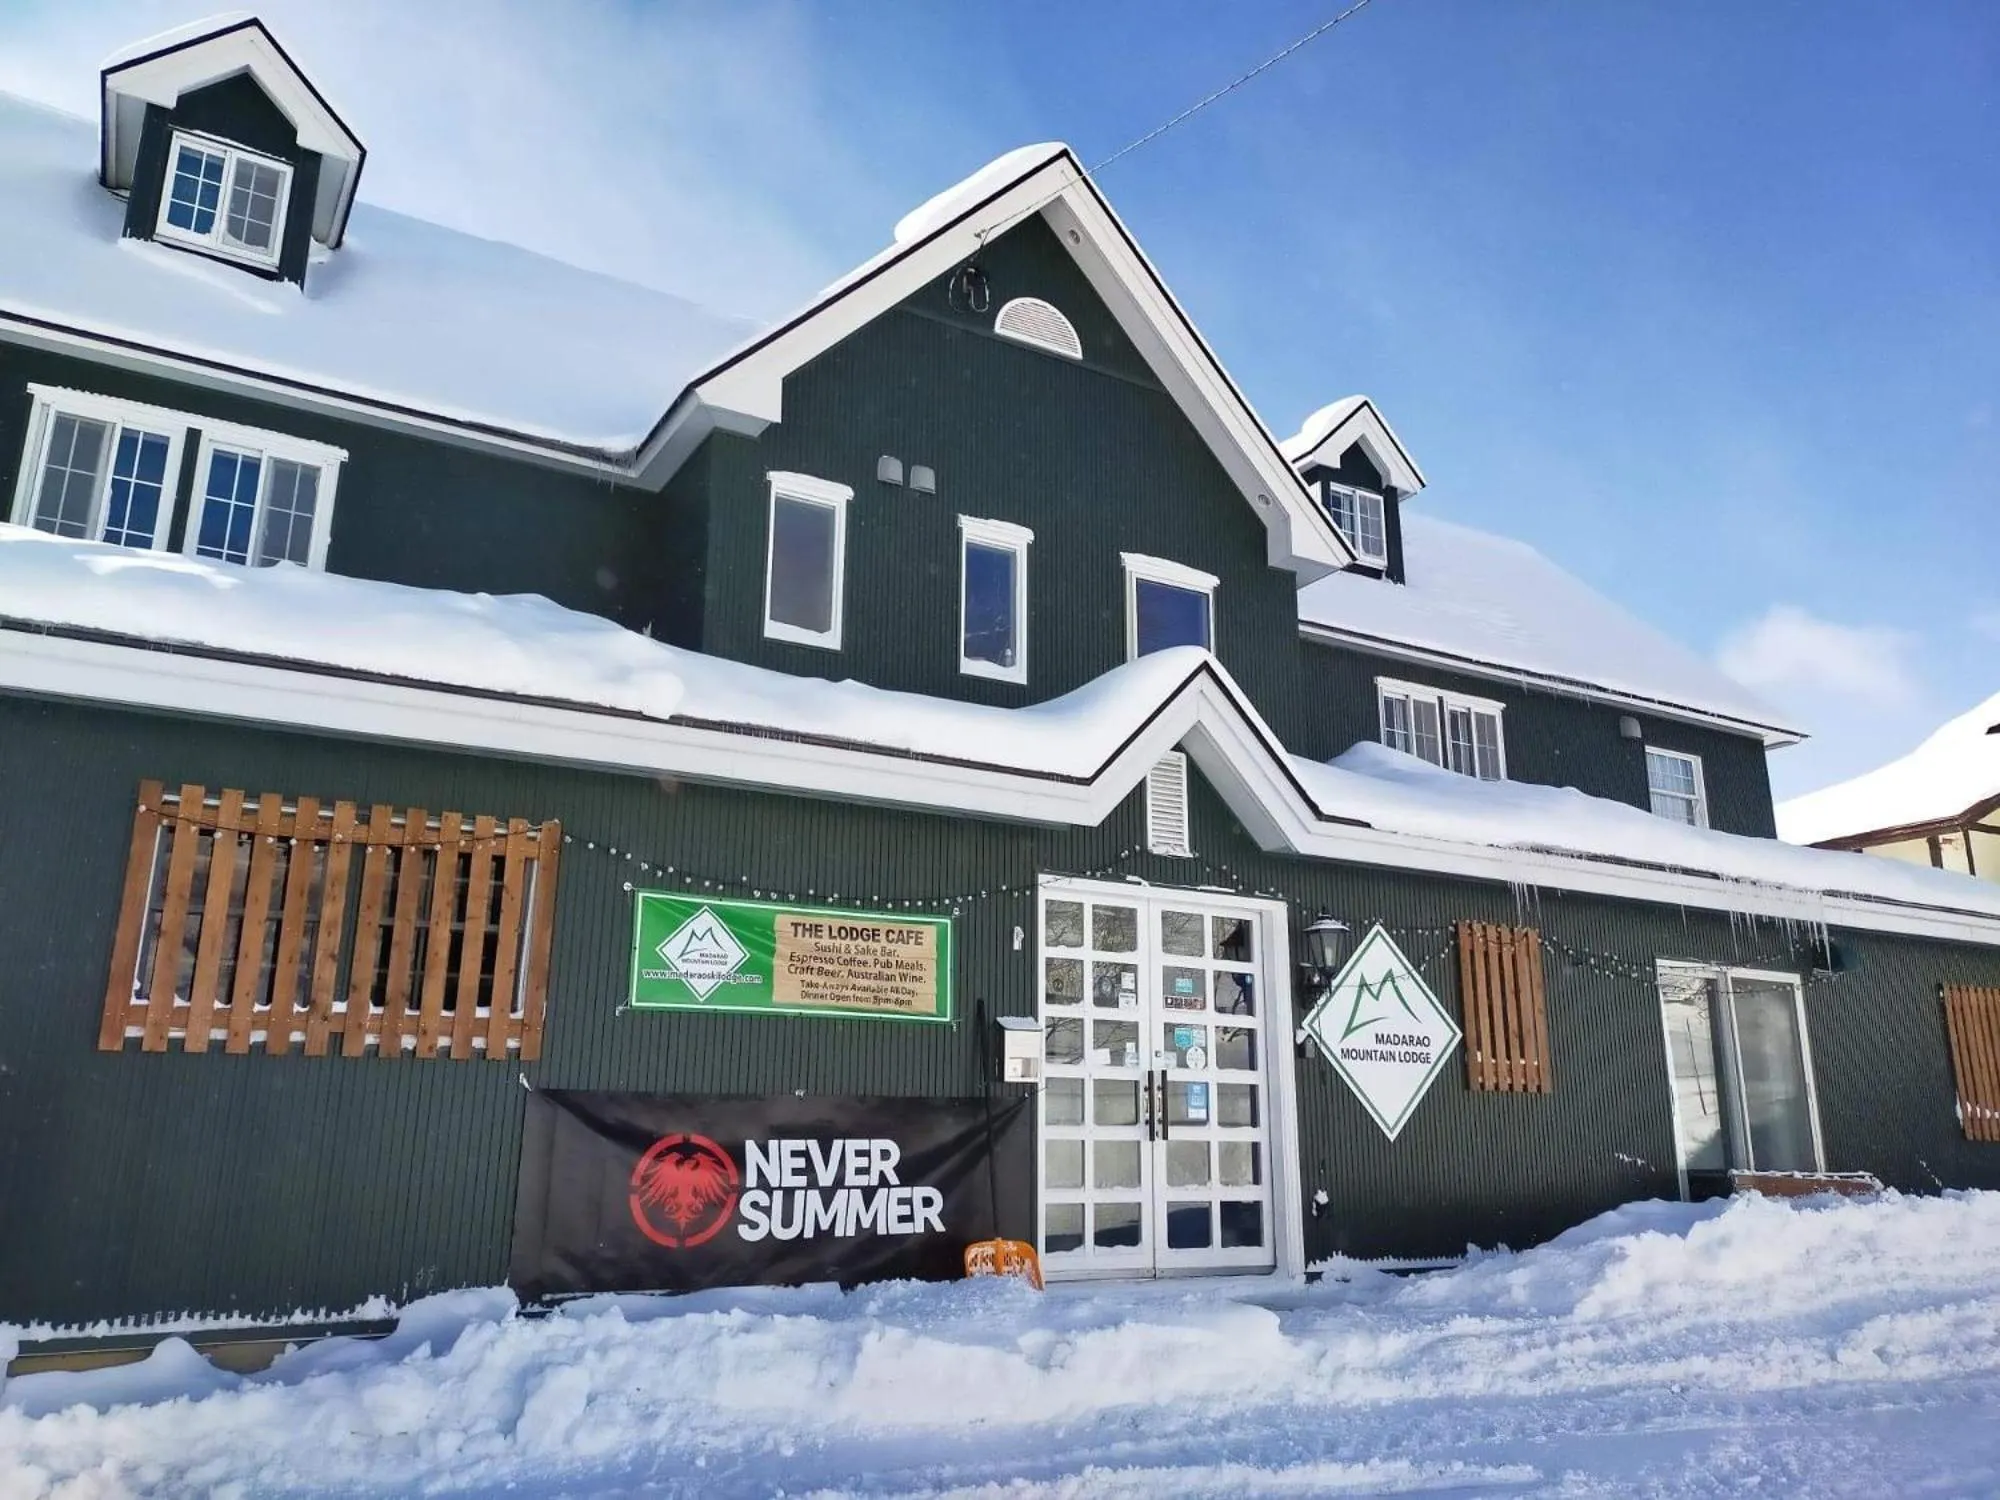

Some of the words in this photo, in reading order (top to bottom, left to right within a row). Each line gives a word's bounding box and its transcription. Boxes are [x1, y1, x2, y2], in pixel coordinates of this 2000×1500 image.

[791, 922, 823, 939] THE
[828, 925, 881, 943] LODGE
[885, 929, 924, 945] CAFE
[814, 942, 841, 954] Sushi
[844, 944, 851, 954] &
[854, 945, 878, 956] Sake
[880, 947, 899, 958] Bar.
[789, 952, 834, 966] Espresso
[836, 956, 871, 968] Coffee.
[874, 959, 892, 970] Pub
[896, 960, 926, 971] Meals.
[788, 964, 814, 975] Craft
[817, 966, 844, 978] Beer.
[847, 969, 896, 982] Australian
[899, 972, 926, 984] Wine.
[801, 991, 828, 1000] Dinner
[830, 993, 850, 1002] Open
[852, 994, 871, 1003] from
[851, 984, 888, 994] Available
[1375, 1032, 1431, 1047] MADARAO
[1340, 1048, 1397, 1063] MOUNTAIN
[1399, 1050, 1431, 1064] LODGE
[744, 1138, 901, 1188] NEVER
[737, 1186, 946, 1242] SUMMER
